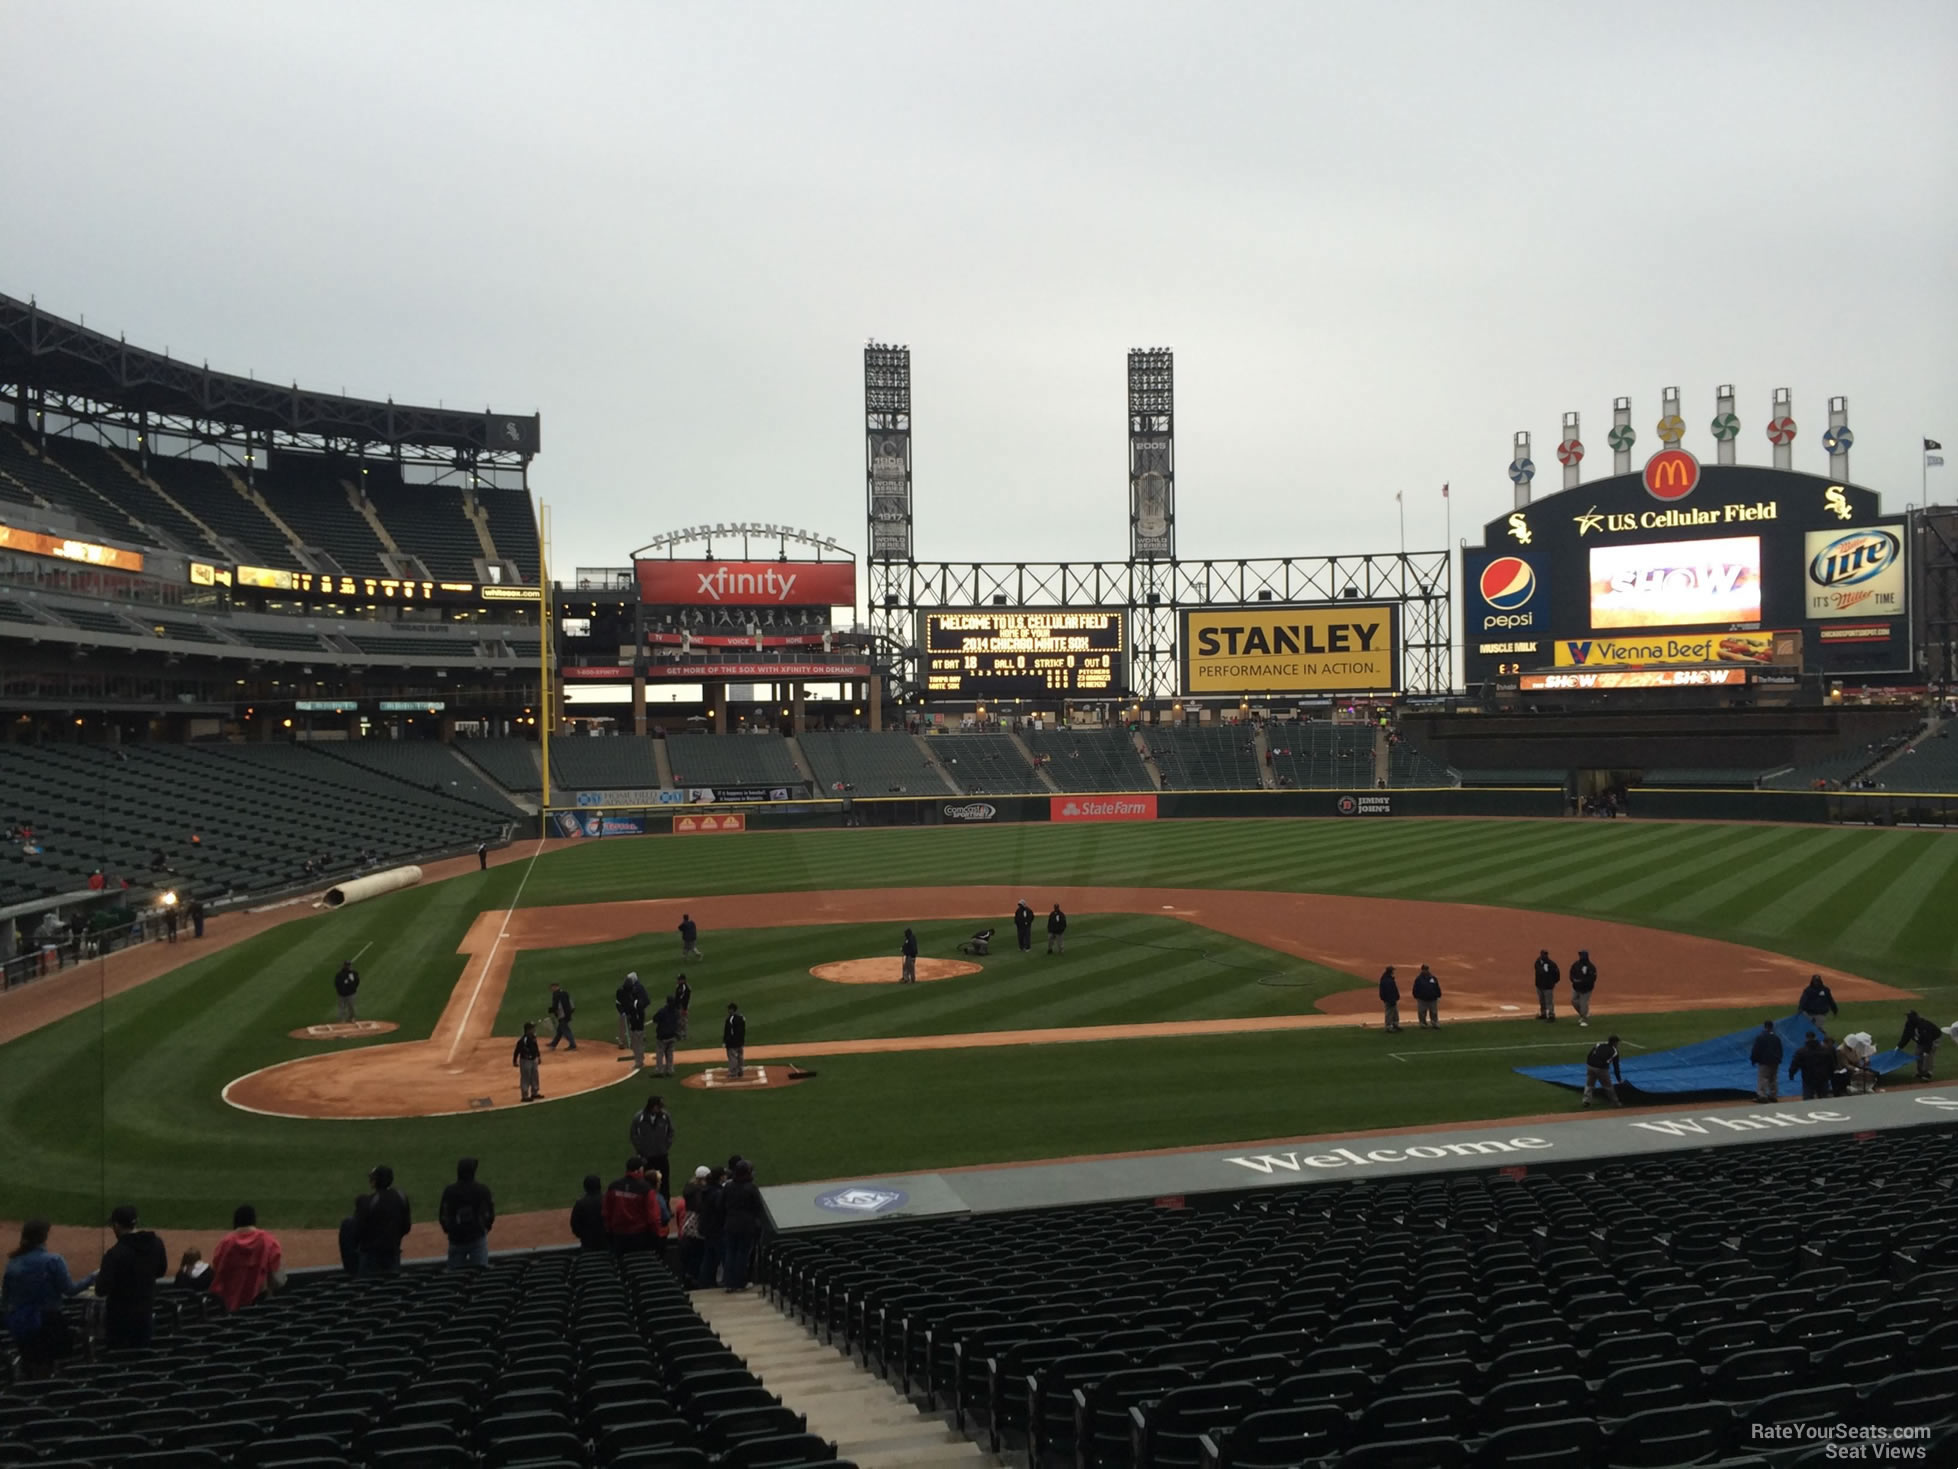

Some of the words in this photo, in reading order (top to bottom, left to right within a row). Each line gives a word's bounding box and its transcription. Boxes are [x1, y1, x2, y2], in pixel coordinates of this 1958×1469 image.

[1135, 442, 1166, 450] 2005
[877, 513, 903, 521] 1917
[1607, 513, 1638, 532] U.S.
[1640, 508, 1721, 529] Cellular
[1724, 501, 1777, 522] Field
[652, 523, 837, 552] FUNDAMENTALS
[1838, 537, 1867, 554] Miller
[1824, 538, 1888, 587] Lite
[697, 567, 797, 601] xfinity
[485, 589, 540, 597] whitesox.com
[1813, 596, 1829, 608] IT'S
[1831, 589, 1874, 610] Miller
[1875, 593, 1896, 604] TIME
[940, 617, 990, 630] WELCOME
[993, 617, 1007, 629] TO
[1008, 617, 1026, 629] U.S.
[1028, 616, 1079, 629] CELLULAR
[1080, 616, 1108, 629] FIELD
[1483, 612, 1533, 630] pepsi
[999, 629, 1018, 638] HOME
[1020, 629, 1030, 638] OF
[1031, 629, 1050, 638] YOUR
[1198, 623, 1380, 656] STANLEY
[962, 638, 988, 650] 2014
[989, 637, 1034, 650] CHICAGO
[1034, 637, 1067, 650] WHITE
[1068, 637, 1089, 650] SOX
[1480, 643, 1514, 654] MUSCLE
[1514, 642, 1537, 653] MILK
[1597, 640, 1663, 660] Vienna
[1668, 639, 1712, 659] Beef
[932, 660, 943, 669] AT
[944, 660, 960, 669] BAT
[964, 656, 978, 669] 18
[994, 659, 1014, 669] BALL
[1017, 656, 1025, 669] 0
[1034, 659, 1064, 668] STRIKE
[1066, 655, 1075, 668] 0
[1084, 658, 1100, 668] OUT
[1102, 655, 1110, 668] 0
[707, 666, 718, 674] OF
[1199, 664, 1299, 677] PERFORMANCE
[1304, 663, 1317, 675] IN
[1321, 662, 1374, 675] ACTION
[1546, 674, 1598, 689] SHOW
[1674, 670, 1729, 685] SHOW
[1358, 797, 1390, 805] JIMMY
[1358, 805, 1390, 814] JOHN'S
[1222, 1133, 1555, 1177] Welcome
[1627, 1105, 1853, 1139] White
